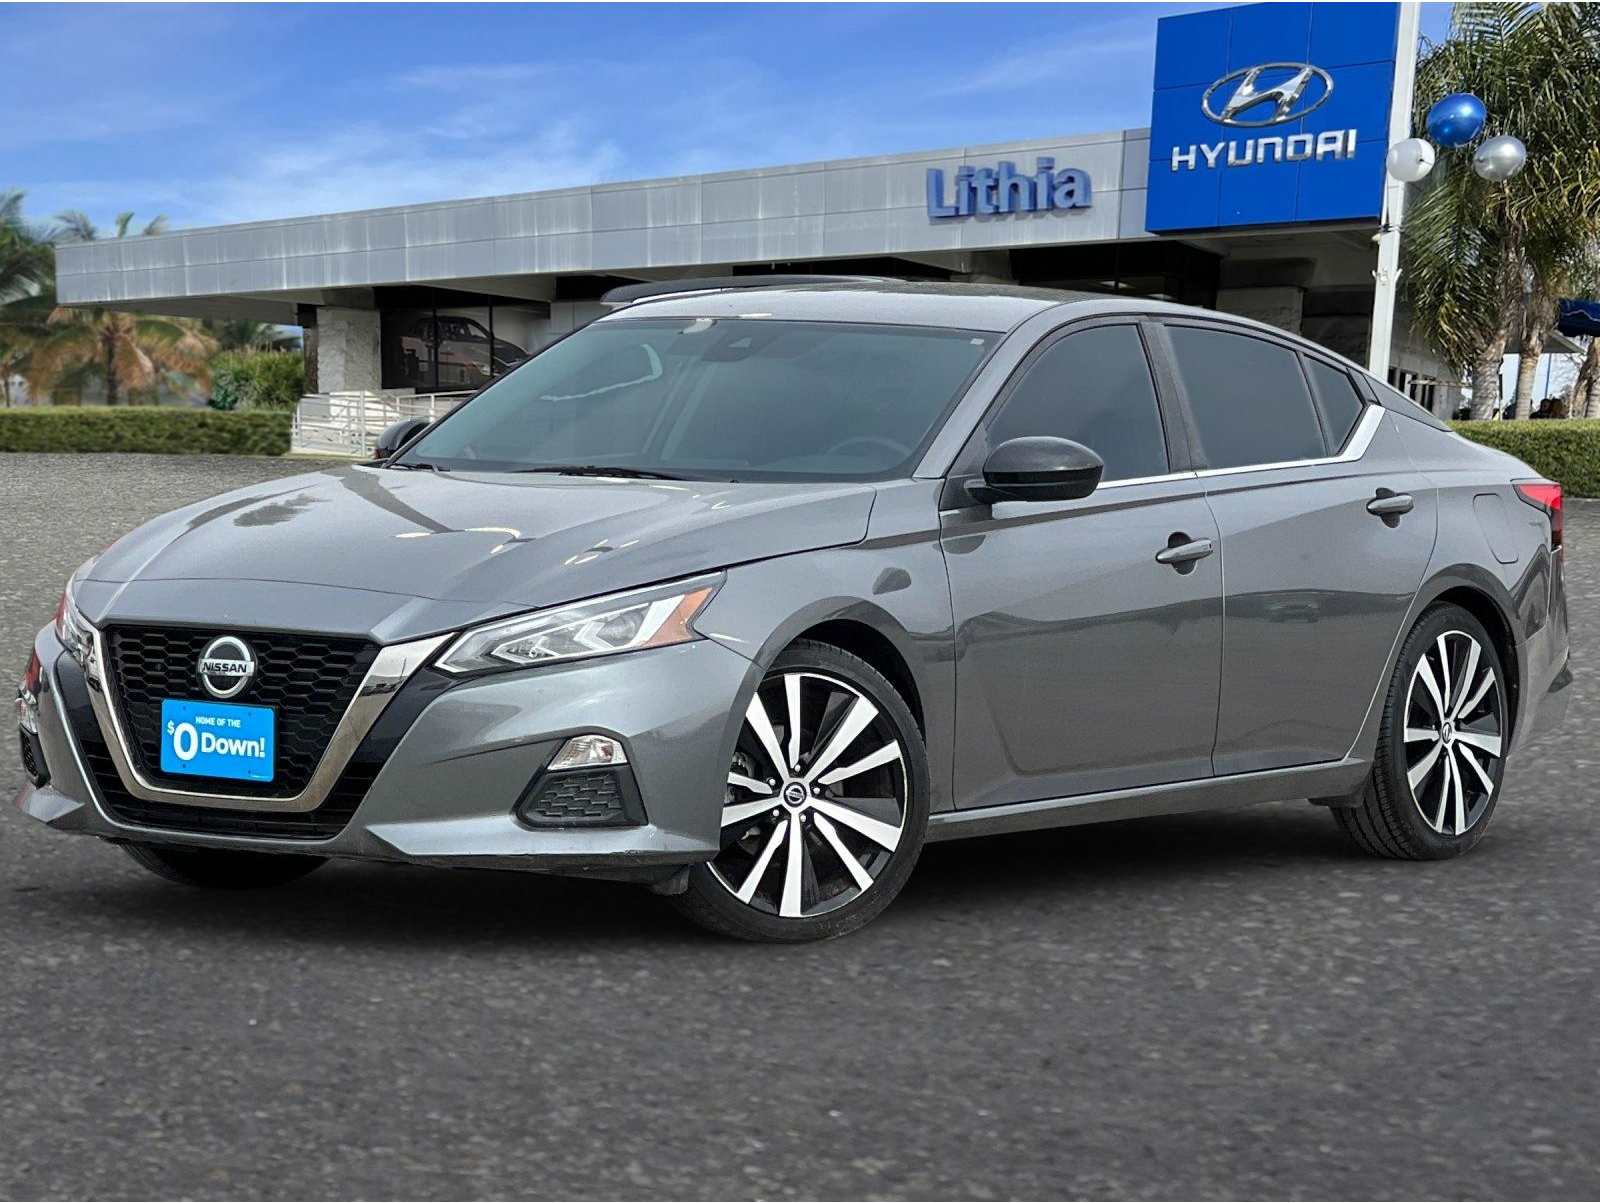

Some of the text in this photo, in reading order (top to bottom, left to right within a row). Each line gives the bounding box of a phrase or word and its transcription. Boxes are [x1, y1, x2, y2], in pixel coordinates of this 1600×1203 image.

[1171, 129, 1357, 171] HYUNDAI
[926, 156, 1092, 219] Lithia
[202, 662, 247, 673] NISSAN
[195, 716, 241, 728] HOME OF THE
[201, 732, 266, 758] Down!
